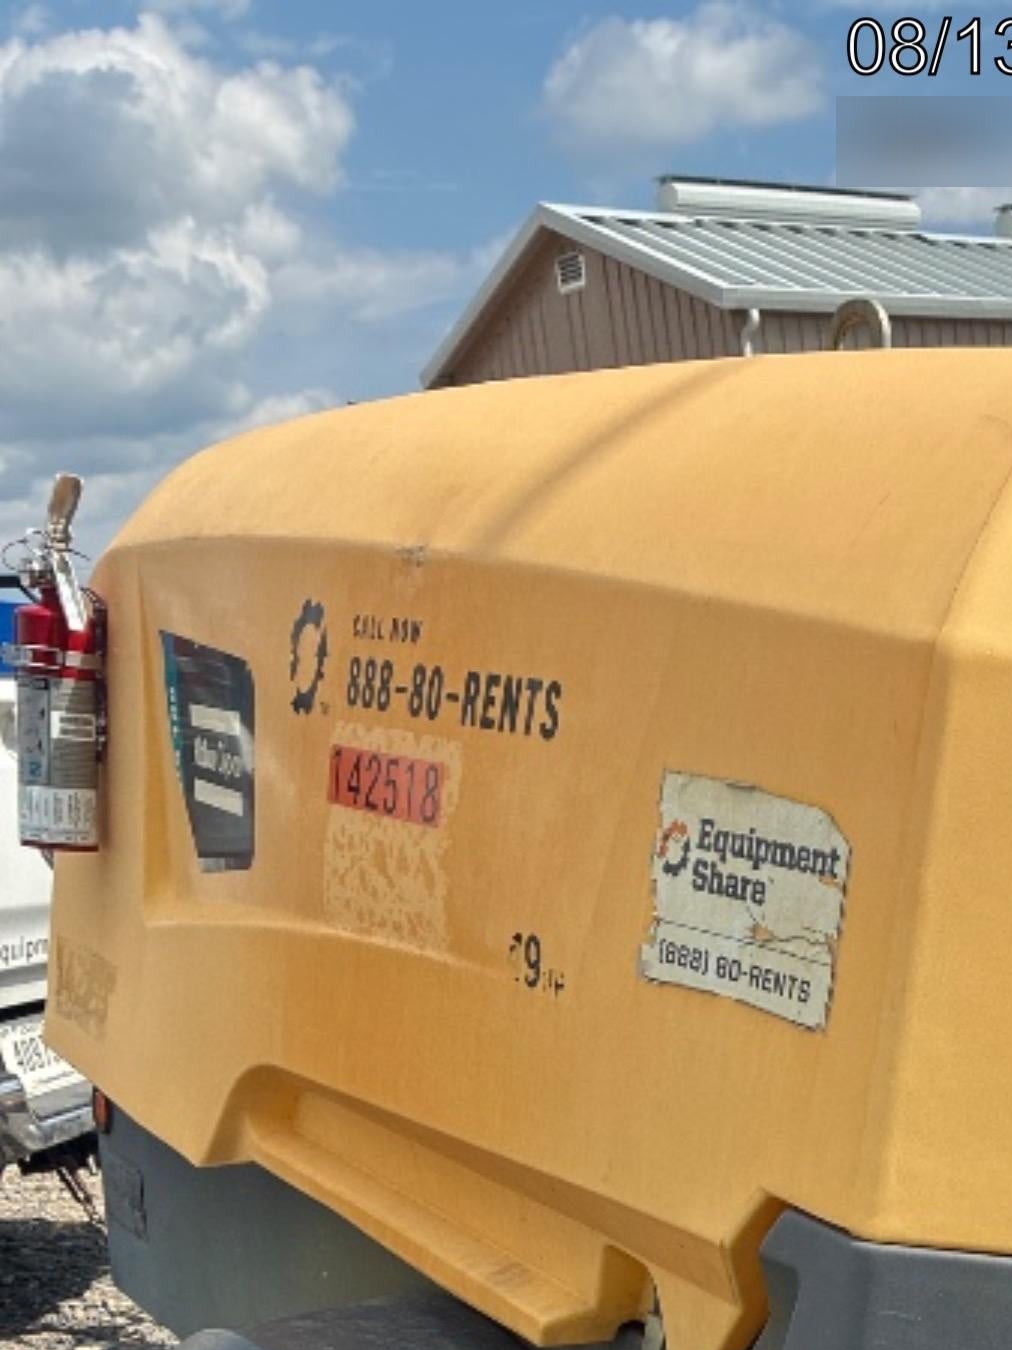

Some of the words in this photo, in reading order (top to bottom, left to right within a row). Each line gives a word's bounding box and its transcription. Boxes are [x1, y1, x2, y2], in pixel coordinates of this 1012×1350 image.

[346, 656, 563, 741] 888-80-RENTS
[332, 747, 442, 823] 142518
[697, 818, 841, 879] Equipment
[691, 859, 767, 906] Share
[509, 932, 541, 988] 9
[715, 956, 812, 1003] 80-RENTS
